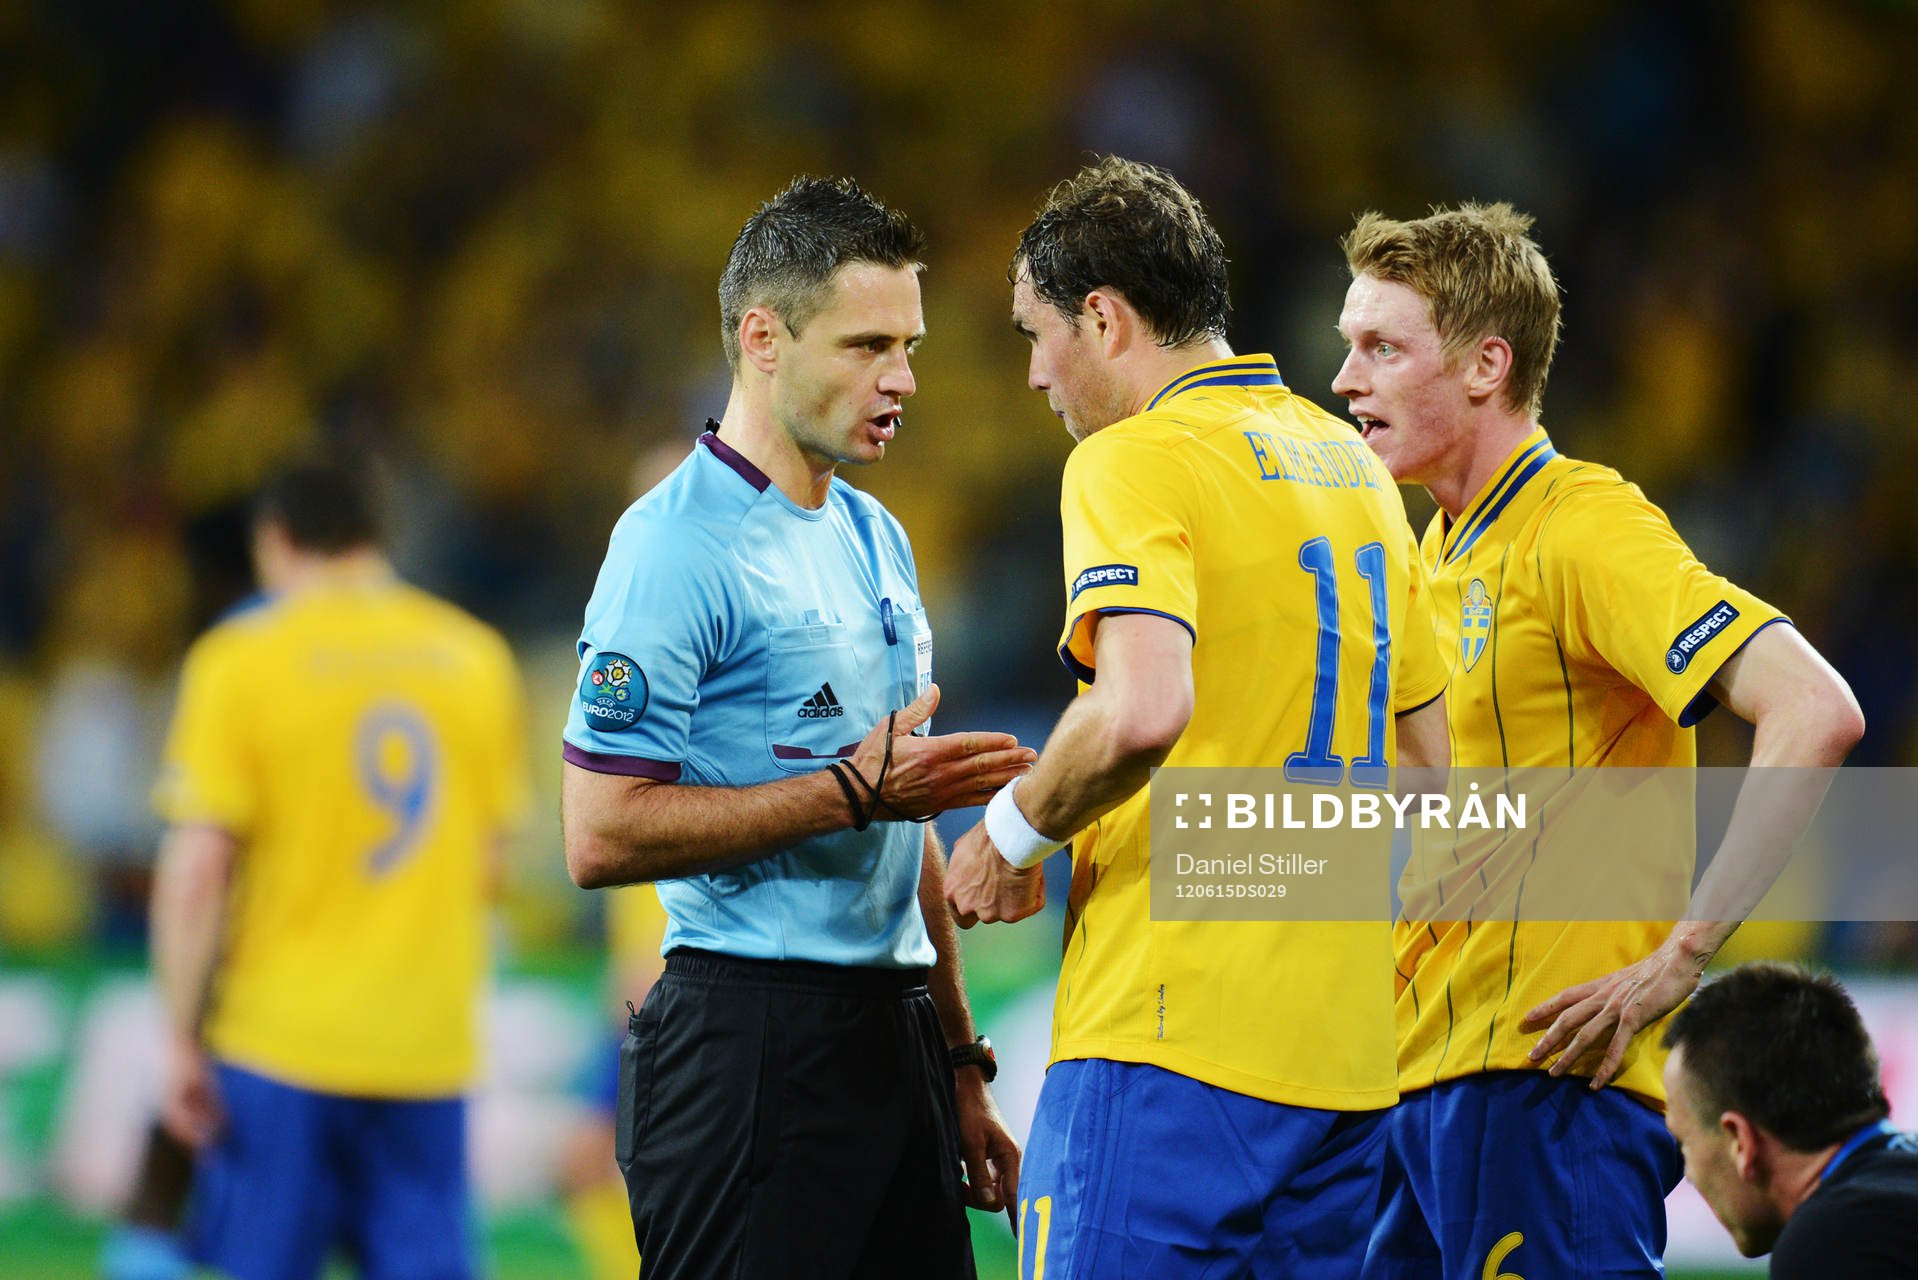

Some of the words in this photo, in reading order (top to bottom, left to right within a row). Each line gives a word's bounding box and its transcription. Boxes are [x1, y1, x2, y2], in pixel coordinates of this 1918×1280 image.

[1075, 568, 1135, 591] RESPECT
[1678, 605, 1733, 653] RESPECT
[1283, 536, 1390, 789] 11
[797, 705, 844, 719] adidas
[353, 699, 438, 877] 9
[1018, 1195, 1052, 1280] 11
